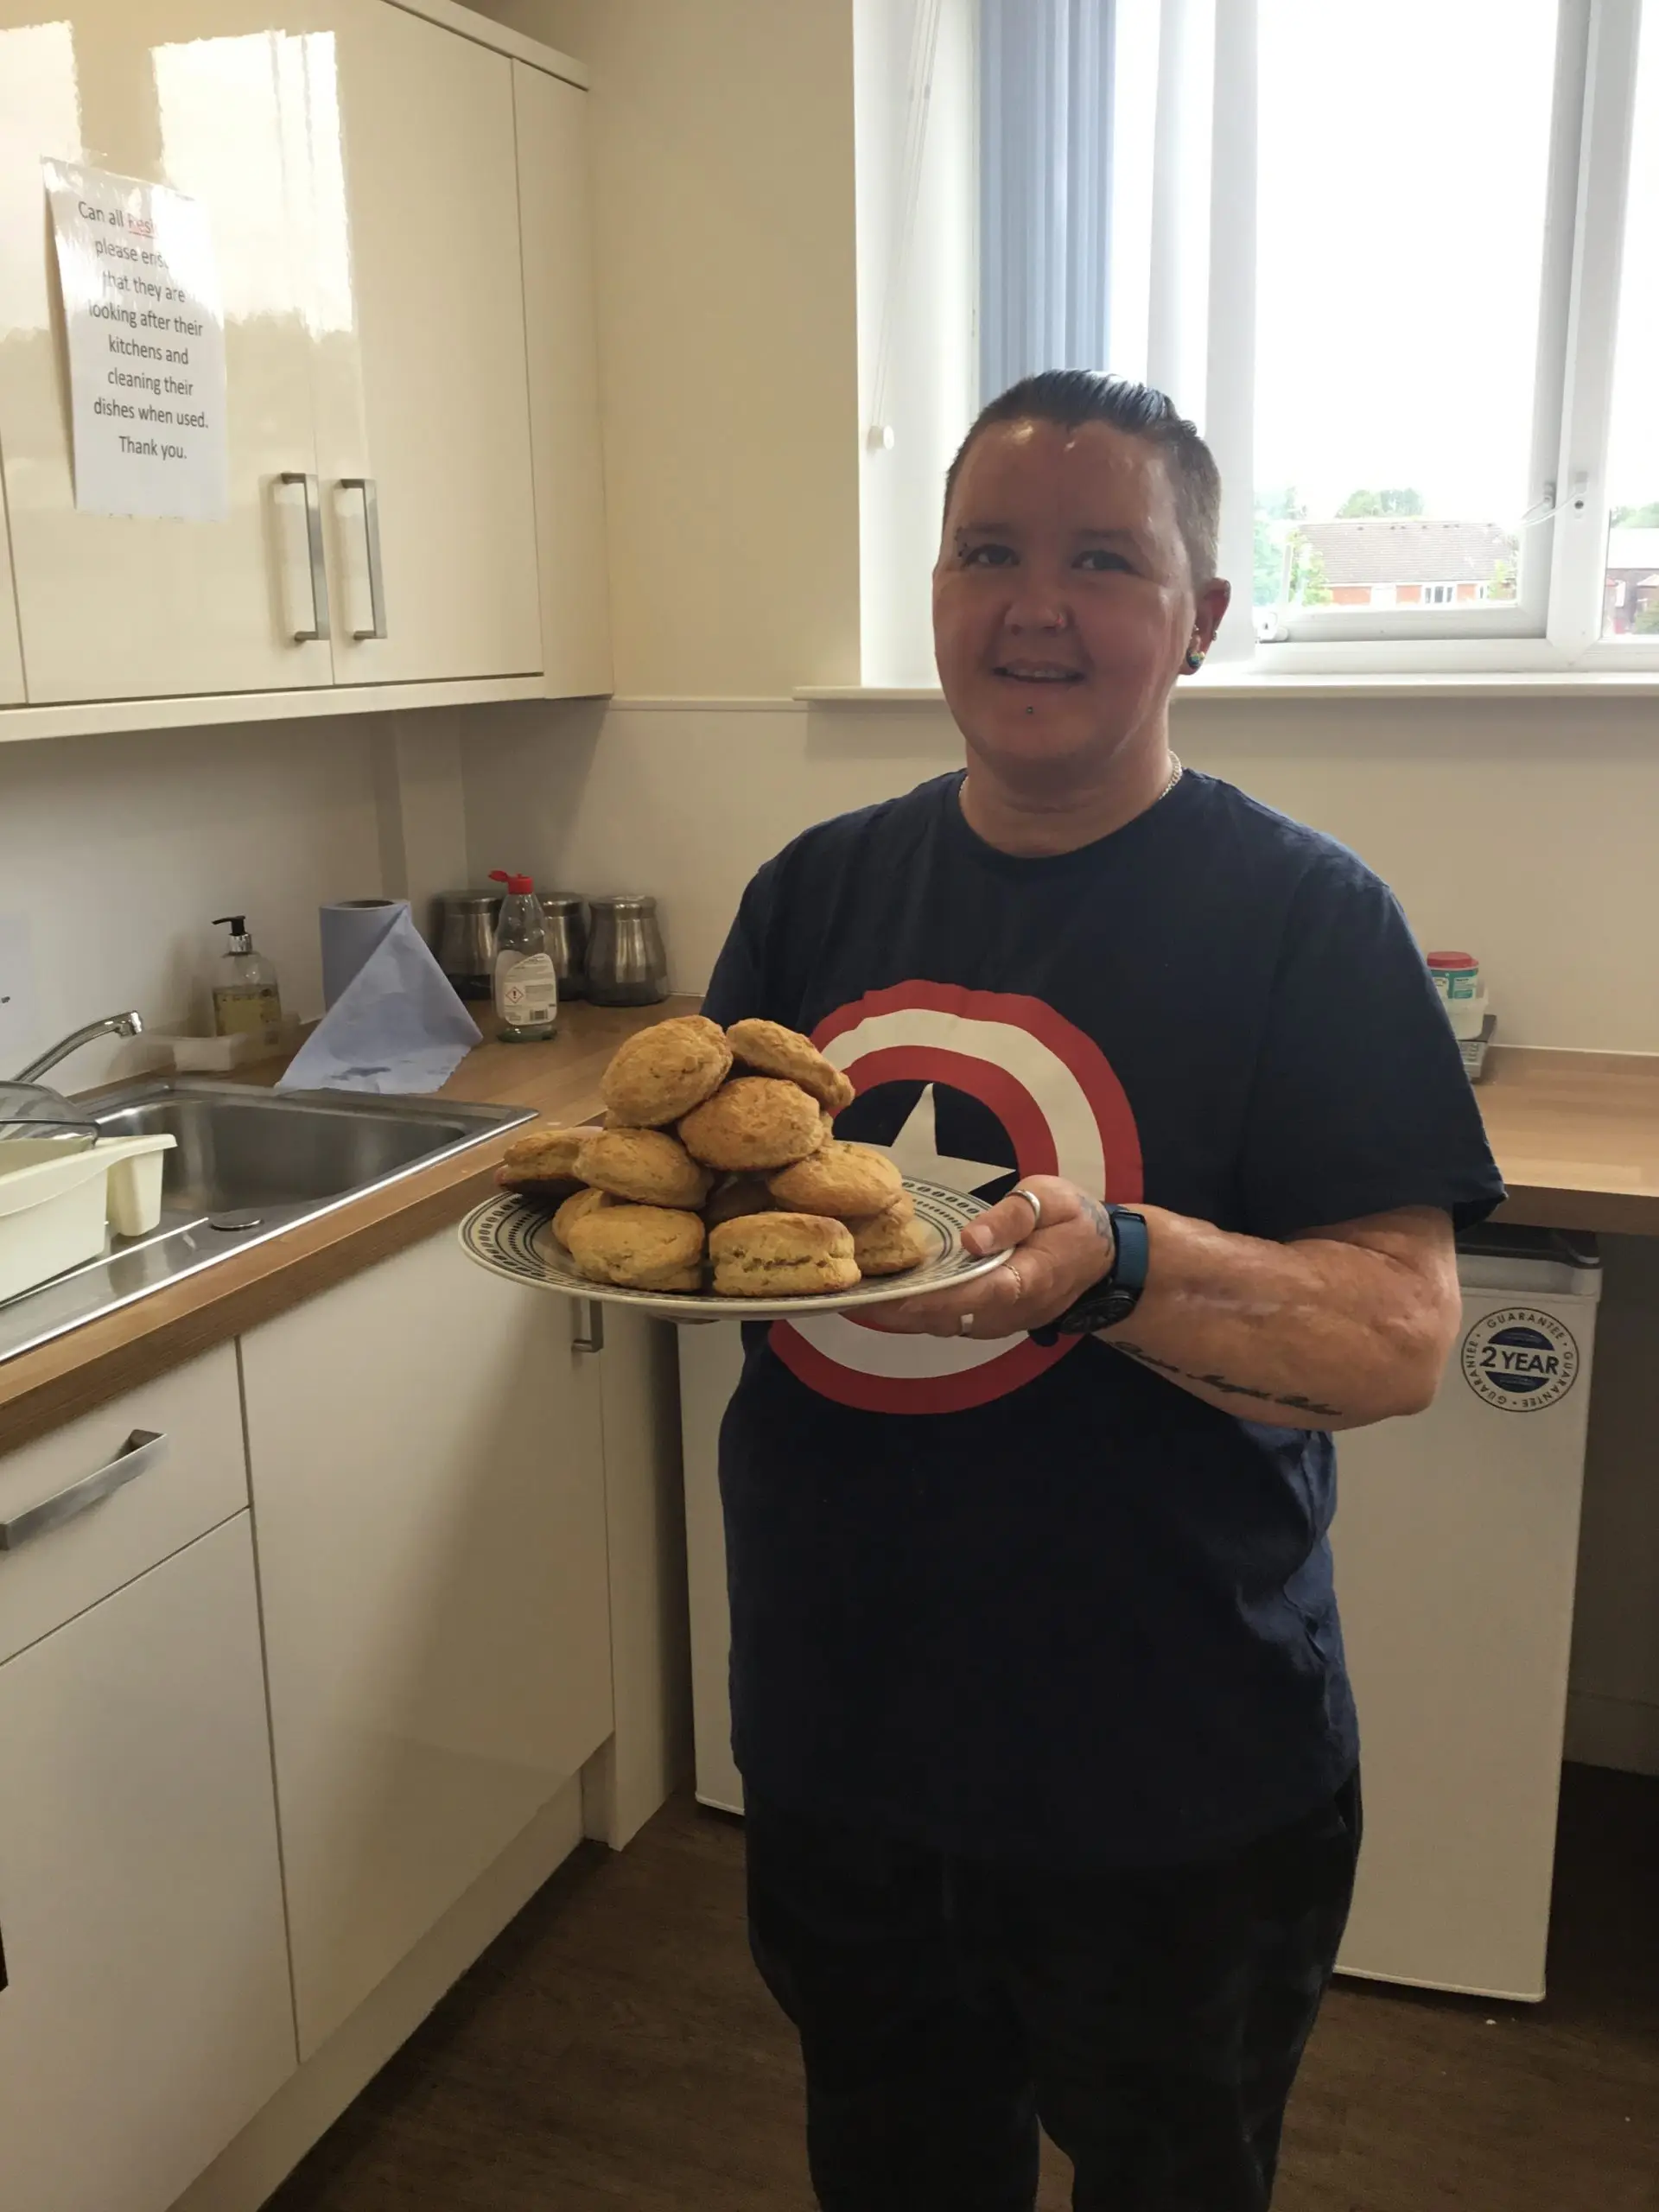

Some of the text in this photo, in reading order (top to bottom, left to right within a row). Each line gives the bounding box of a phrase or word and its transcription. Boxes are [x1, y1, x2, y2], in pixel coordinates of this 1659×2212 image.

[78, 201, 105, 222] Can
[109, 209, 124, 227] all
[95, 238, 139, 262] please
[103, 270, 186, 303] that they are
[88, 299, 204, 336] looking after their
[108, 334, 189, 365] kitchens and
[107, 366, 194, 396] cleaning their
[93, 397, 209, 429] dishes when used.
[118, 435, 188, 461] Thank you.
[1486, 1312, 1566, 1340] GUARANTEE
[1478, 1345, 1560, 1376] 2 YEAR
[1522, 1351, 1574, 1408] GUARANTEE
